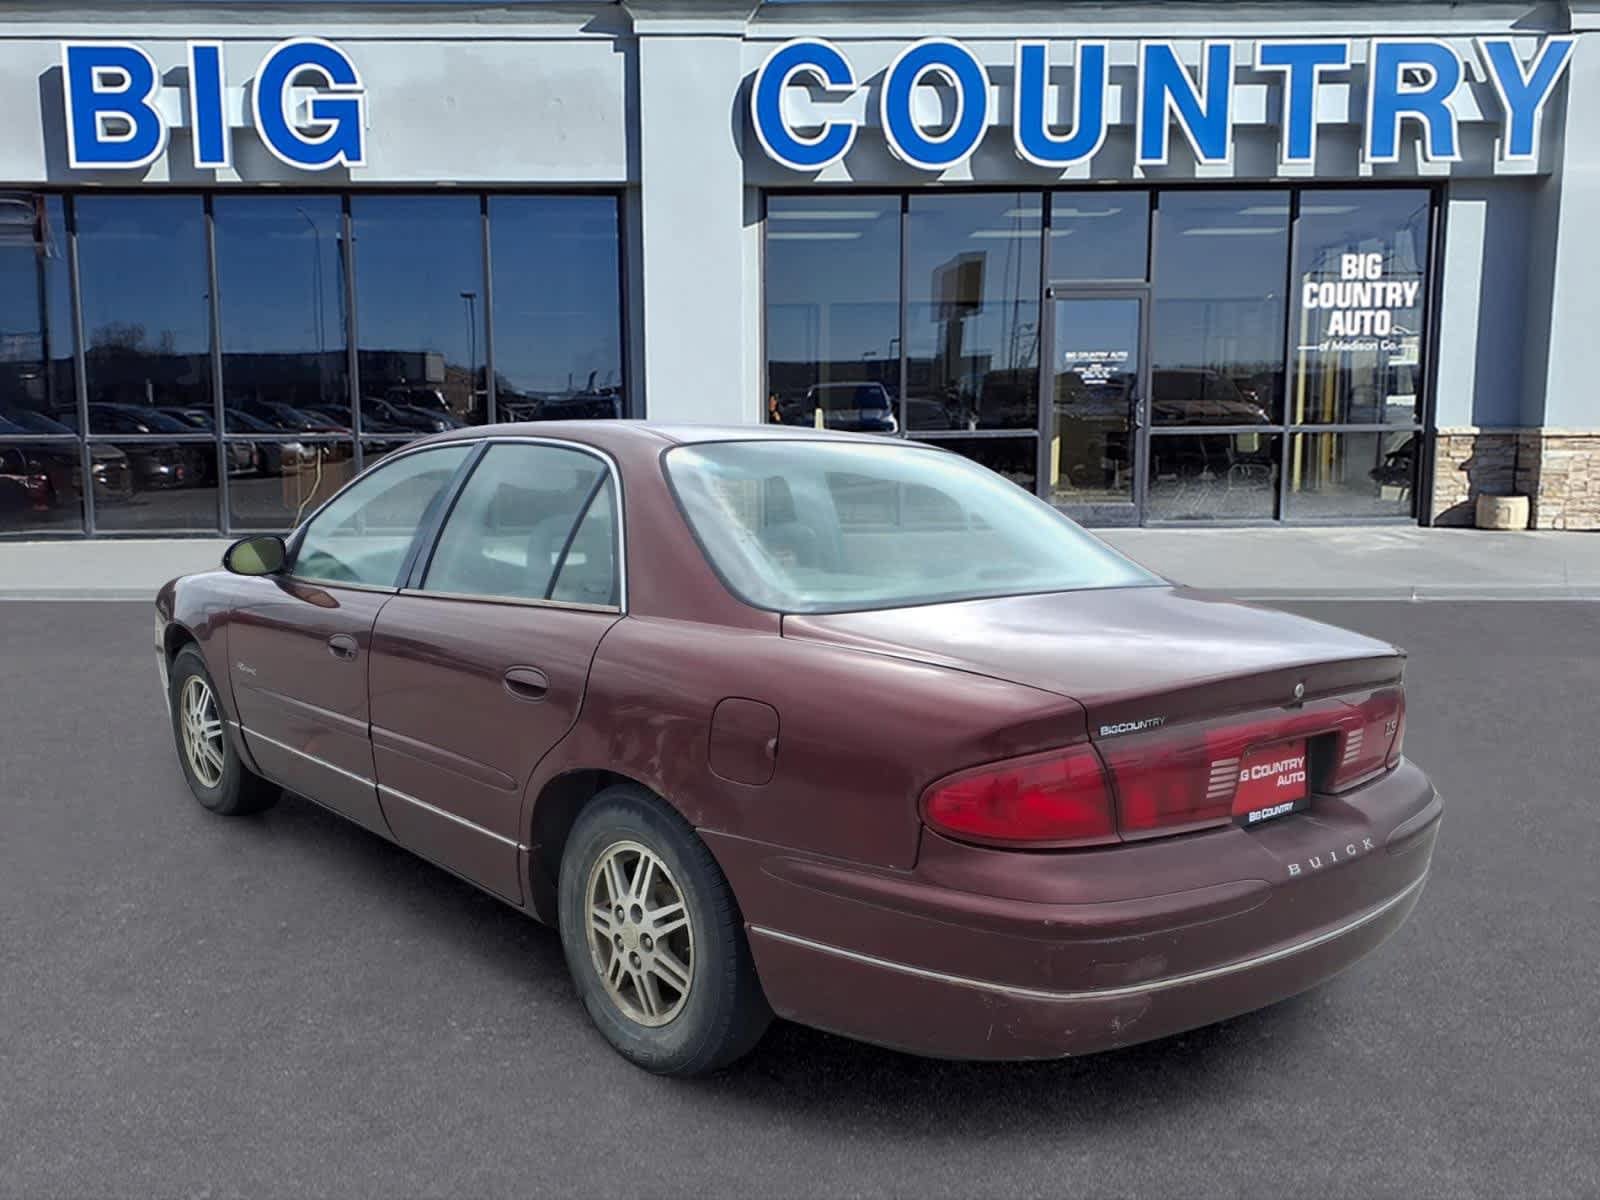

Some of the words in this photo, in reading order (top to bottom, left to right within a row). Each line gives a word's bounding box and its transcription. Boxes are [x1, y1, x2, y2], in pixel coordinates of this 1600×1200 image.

[60, 36, 367, 170] BIG
[750, 36, 1577, 172] COUNTRY
[1341, 253, 1382, 280] BIG
[1303, 281, 1419, 308] COUNTRY
[1328, 310, 1391, 336] AUTO
[1251, 756, 1305, 780] COUNTRY
[1277, 771, 1306, 786] AUTO
[1288, 838, 1375, 876] BUICK
